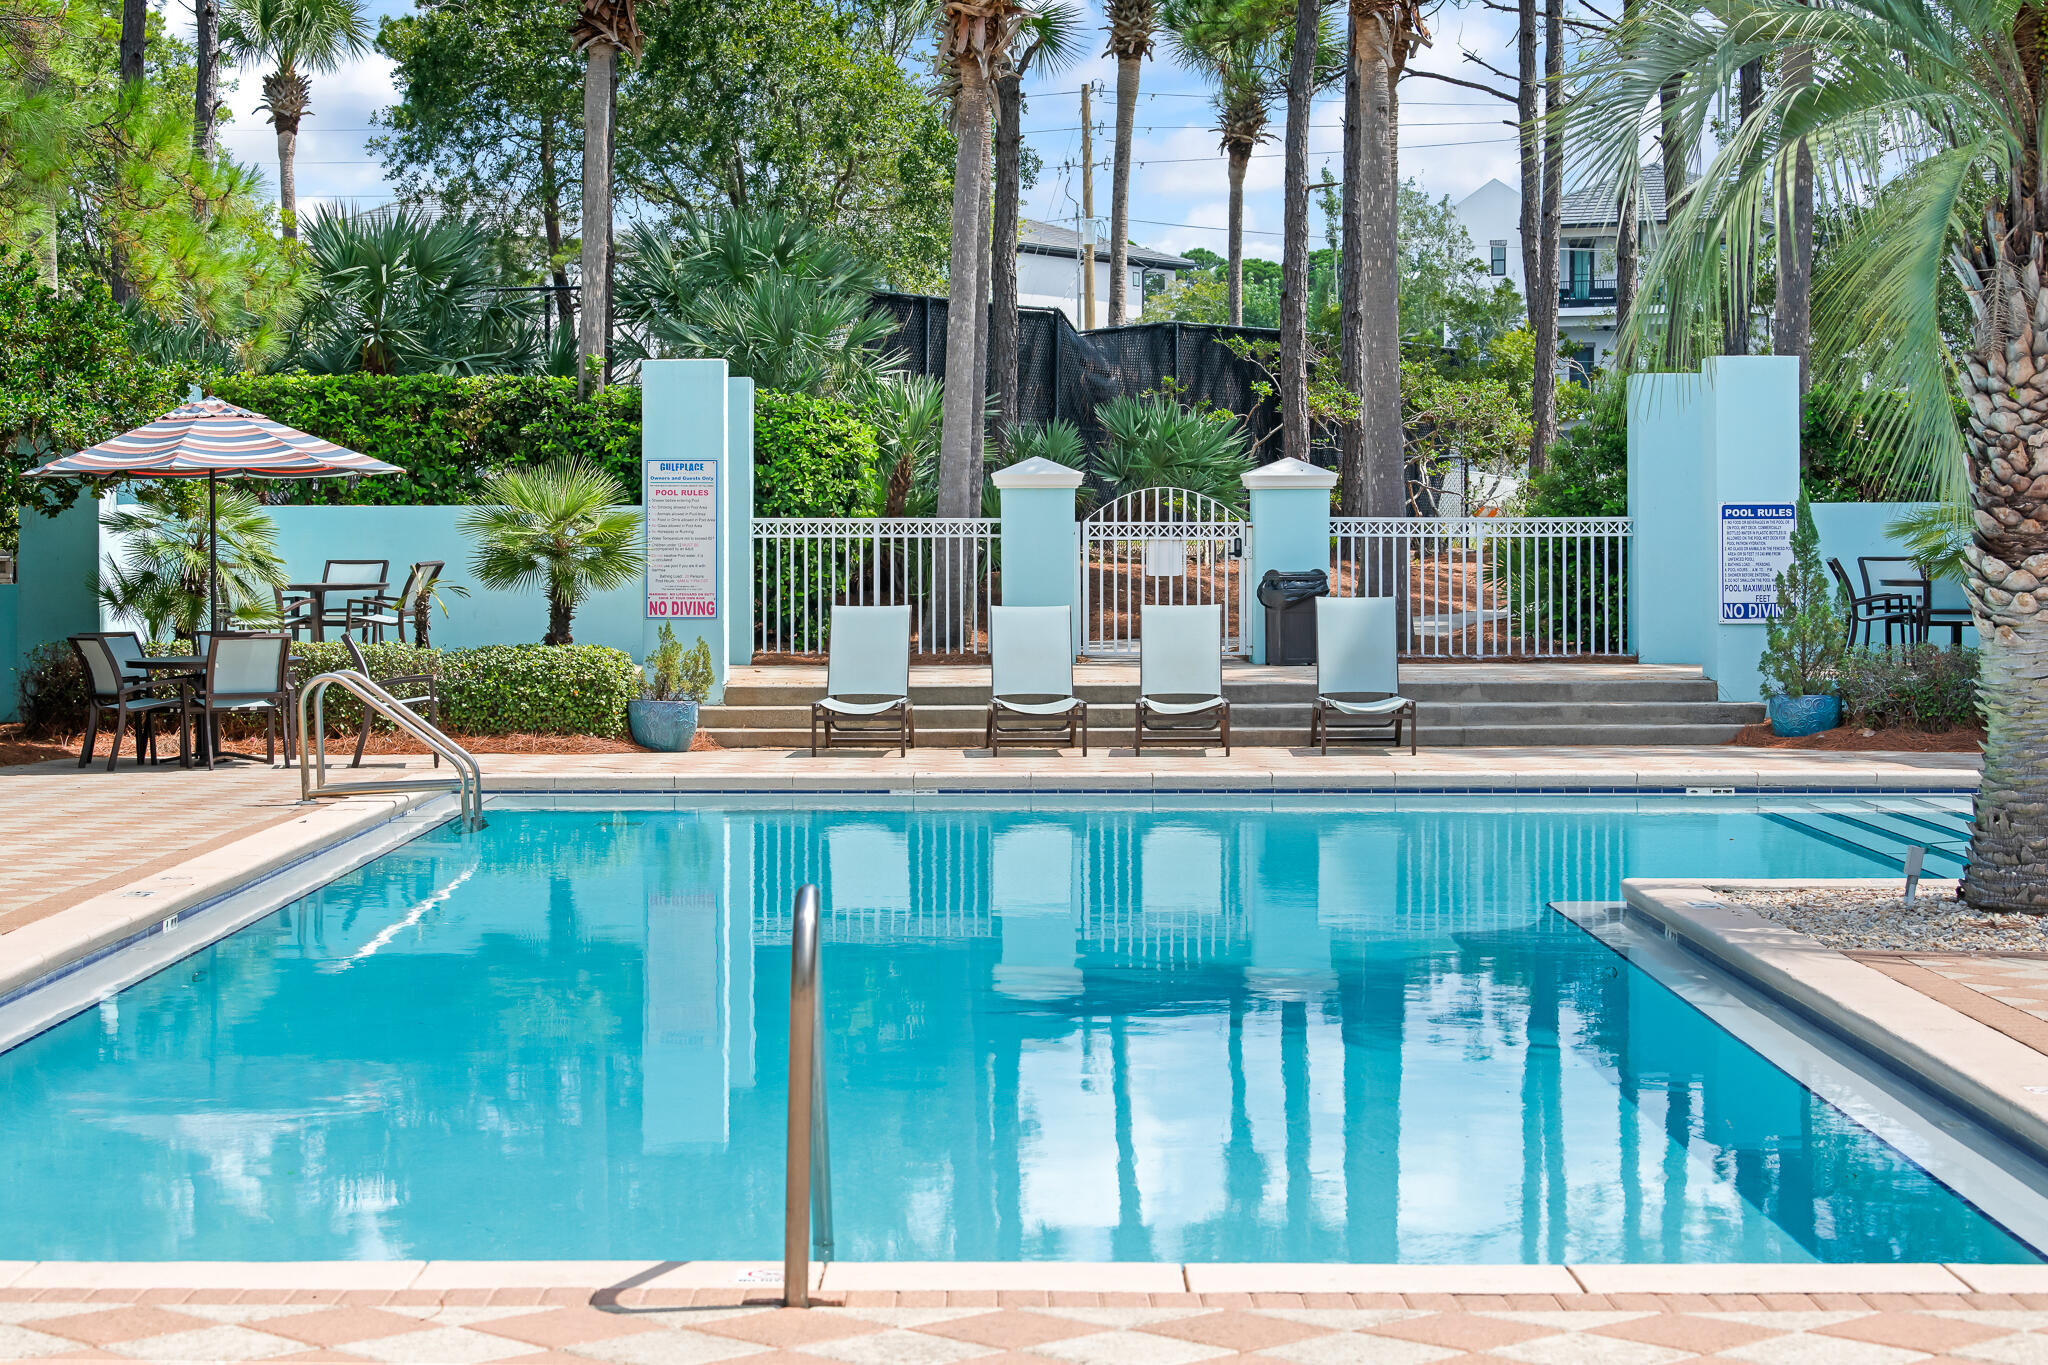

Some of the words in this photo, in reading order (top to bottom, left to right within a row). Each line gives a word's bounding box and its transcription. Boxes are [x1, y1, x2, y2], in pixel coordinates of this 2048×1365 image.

[660, 463, 704, 471] GULFPLACE
[650, 601, 667, 615] NO
[672, 601, 715, 615] DIVING
[1724, 604, 1744, 618] NO
[1749, 604, 1784, 618] DIVIN
